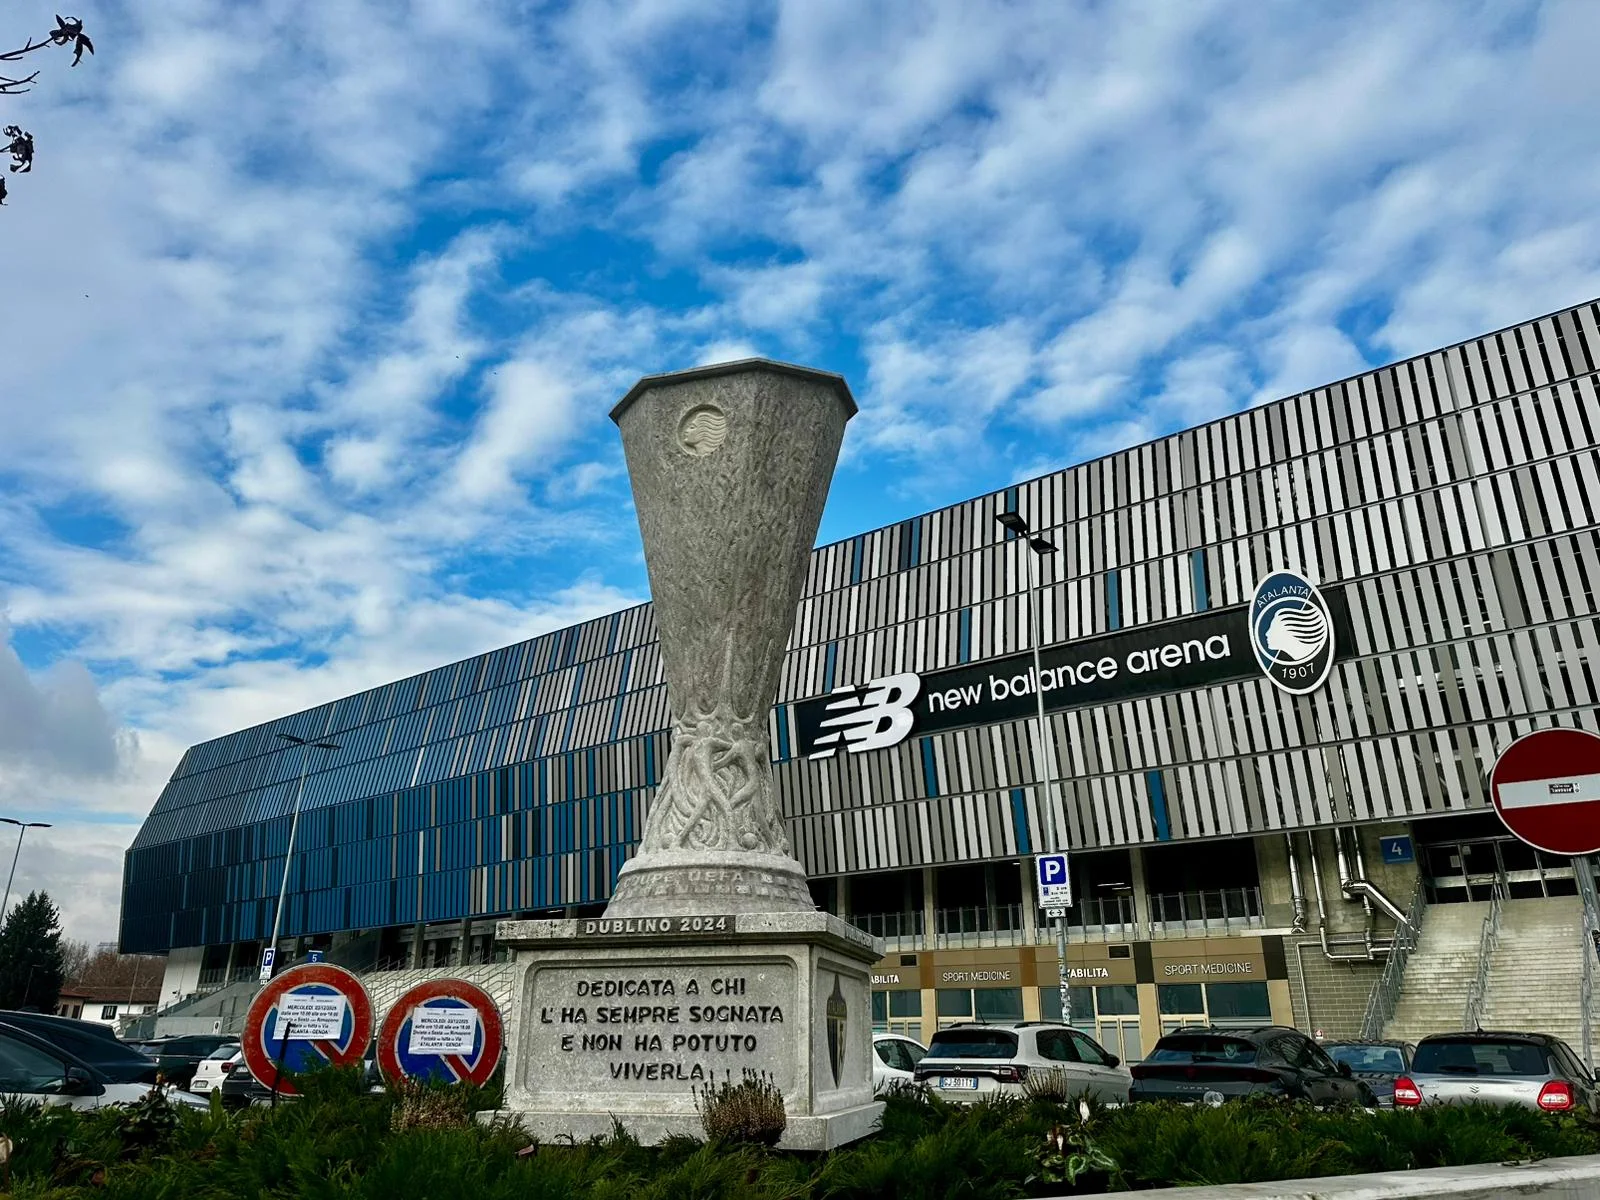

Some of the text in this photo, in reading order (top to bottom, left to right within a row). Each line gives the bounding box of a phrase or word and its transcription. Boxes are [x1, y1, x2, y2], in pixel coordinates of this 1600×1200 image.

[1257, 585, 1309, 608] ATALANTA
[928, 634, 1231, 713] new balance arena
[1281, 662, 1315, 679] 1907
[1391, 841, 1402, 856] 4
[1044, 860, 1061, 882] P
[585, 917, 726, 934] DUBLINO 2024
[265, 952, 272, 964] P
[312, 954, 318, 962] 5
[942, 970, 1011, 982] SPORT MEDICINE
[1067, 968, 1108, 978] ABILITA
[1164, 962, 1253, 976] SPORT MEDICINE
[577, 978, 746, 997] DEDICATA A CHI
[596, 1006, 680, 1023] SEMPRE
[689, 1006, 784, 1022] SOGNATA
[561, 1034, 757, 1052] E NON HA POTUTO
[610, 1062, 704, 1080] VIVERLA
